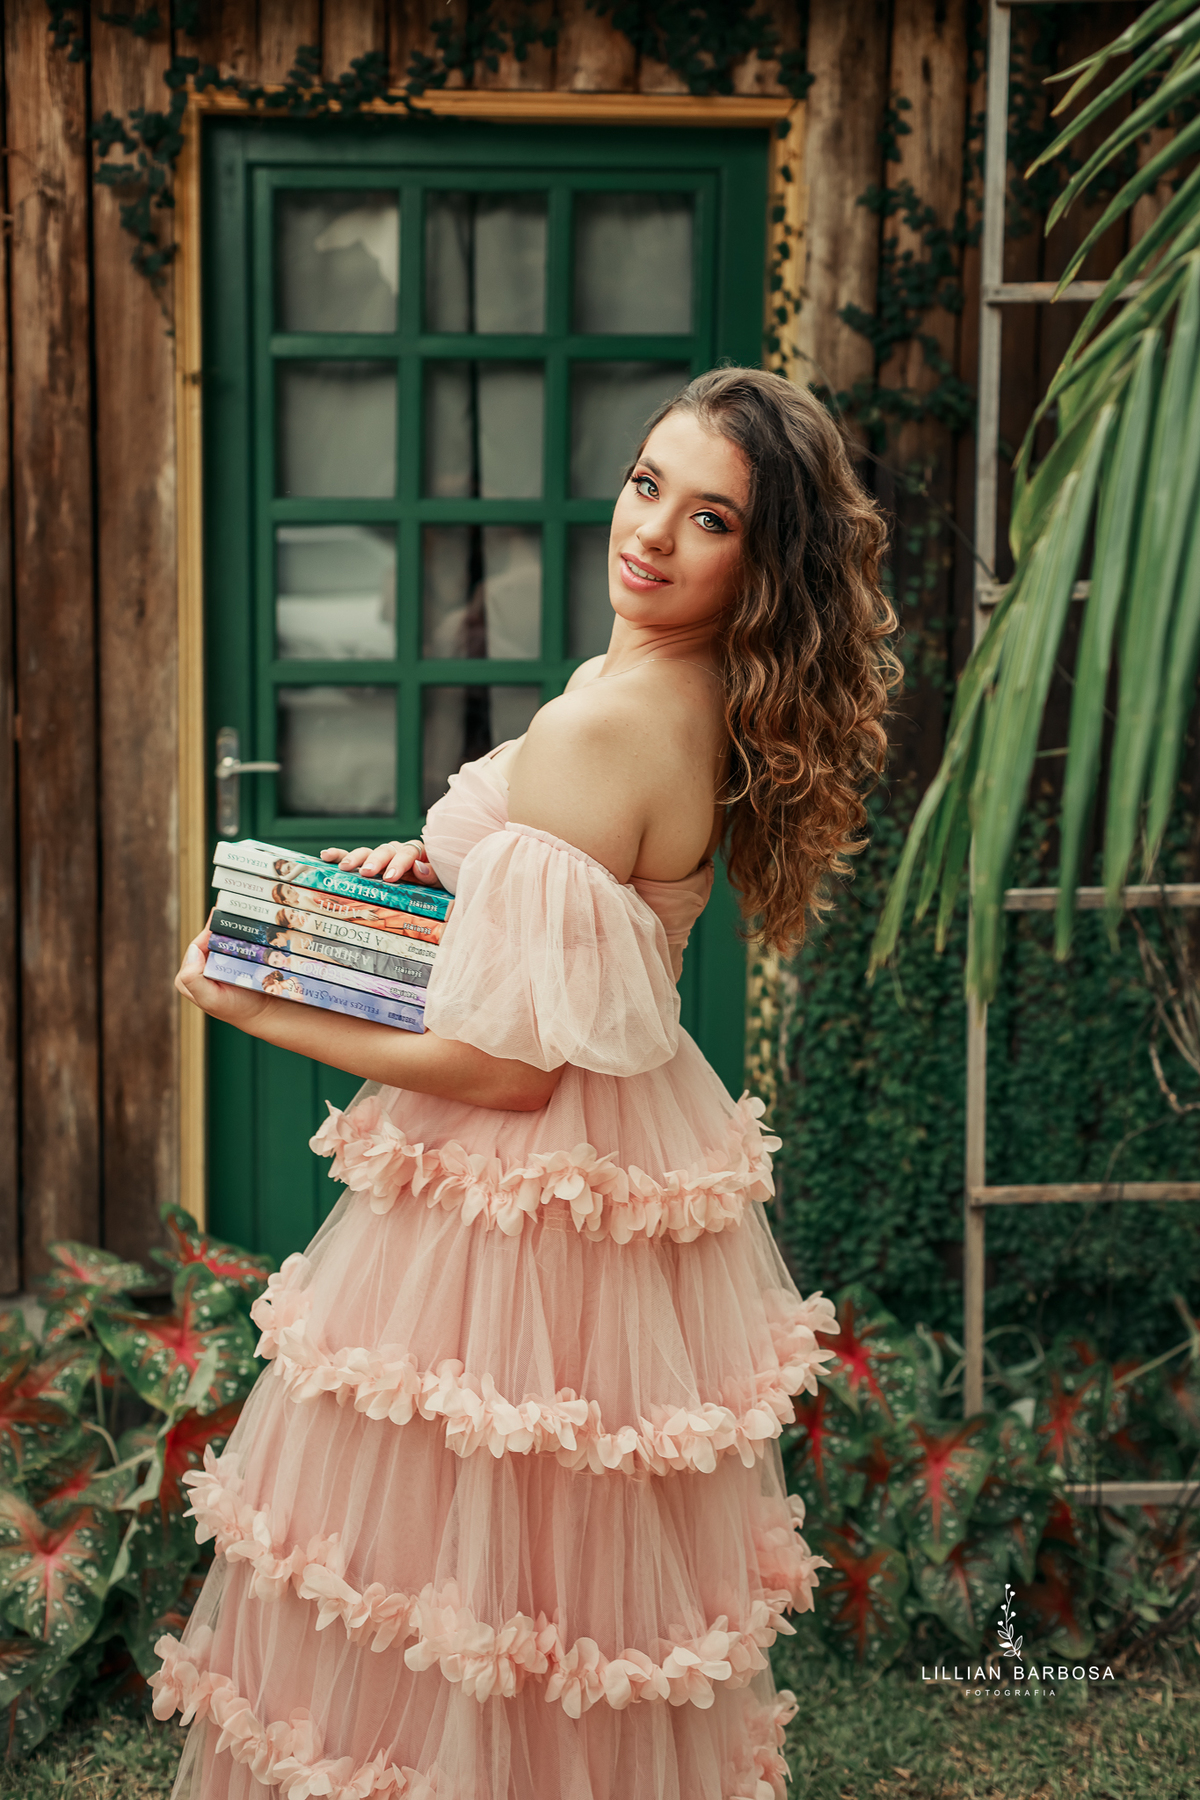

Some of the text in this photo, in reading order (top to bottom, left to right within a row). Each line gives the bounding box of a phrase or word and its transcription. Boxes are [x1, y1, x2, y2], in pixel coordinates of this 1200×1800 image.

[379, 890, 389, 901] A
[318, 898, 361, 919] A ELITE
[219, 919, 260, 935] KIERA CASS
[314, 919, 384, 946] A ESCOLHA
[217, 941, 257, 957] KIERA CASS
[300, 938, 371, 966] A HERDEIRA
[288, 983, 380, 1015] FELIZES PARA SEMPRE
